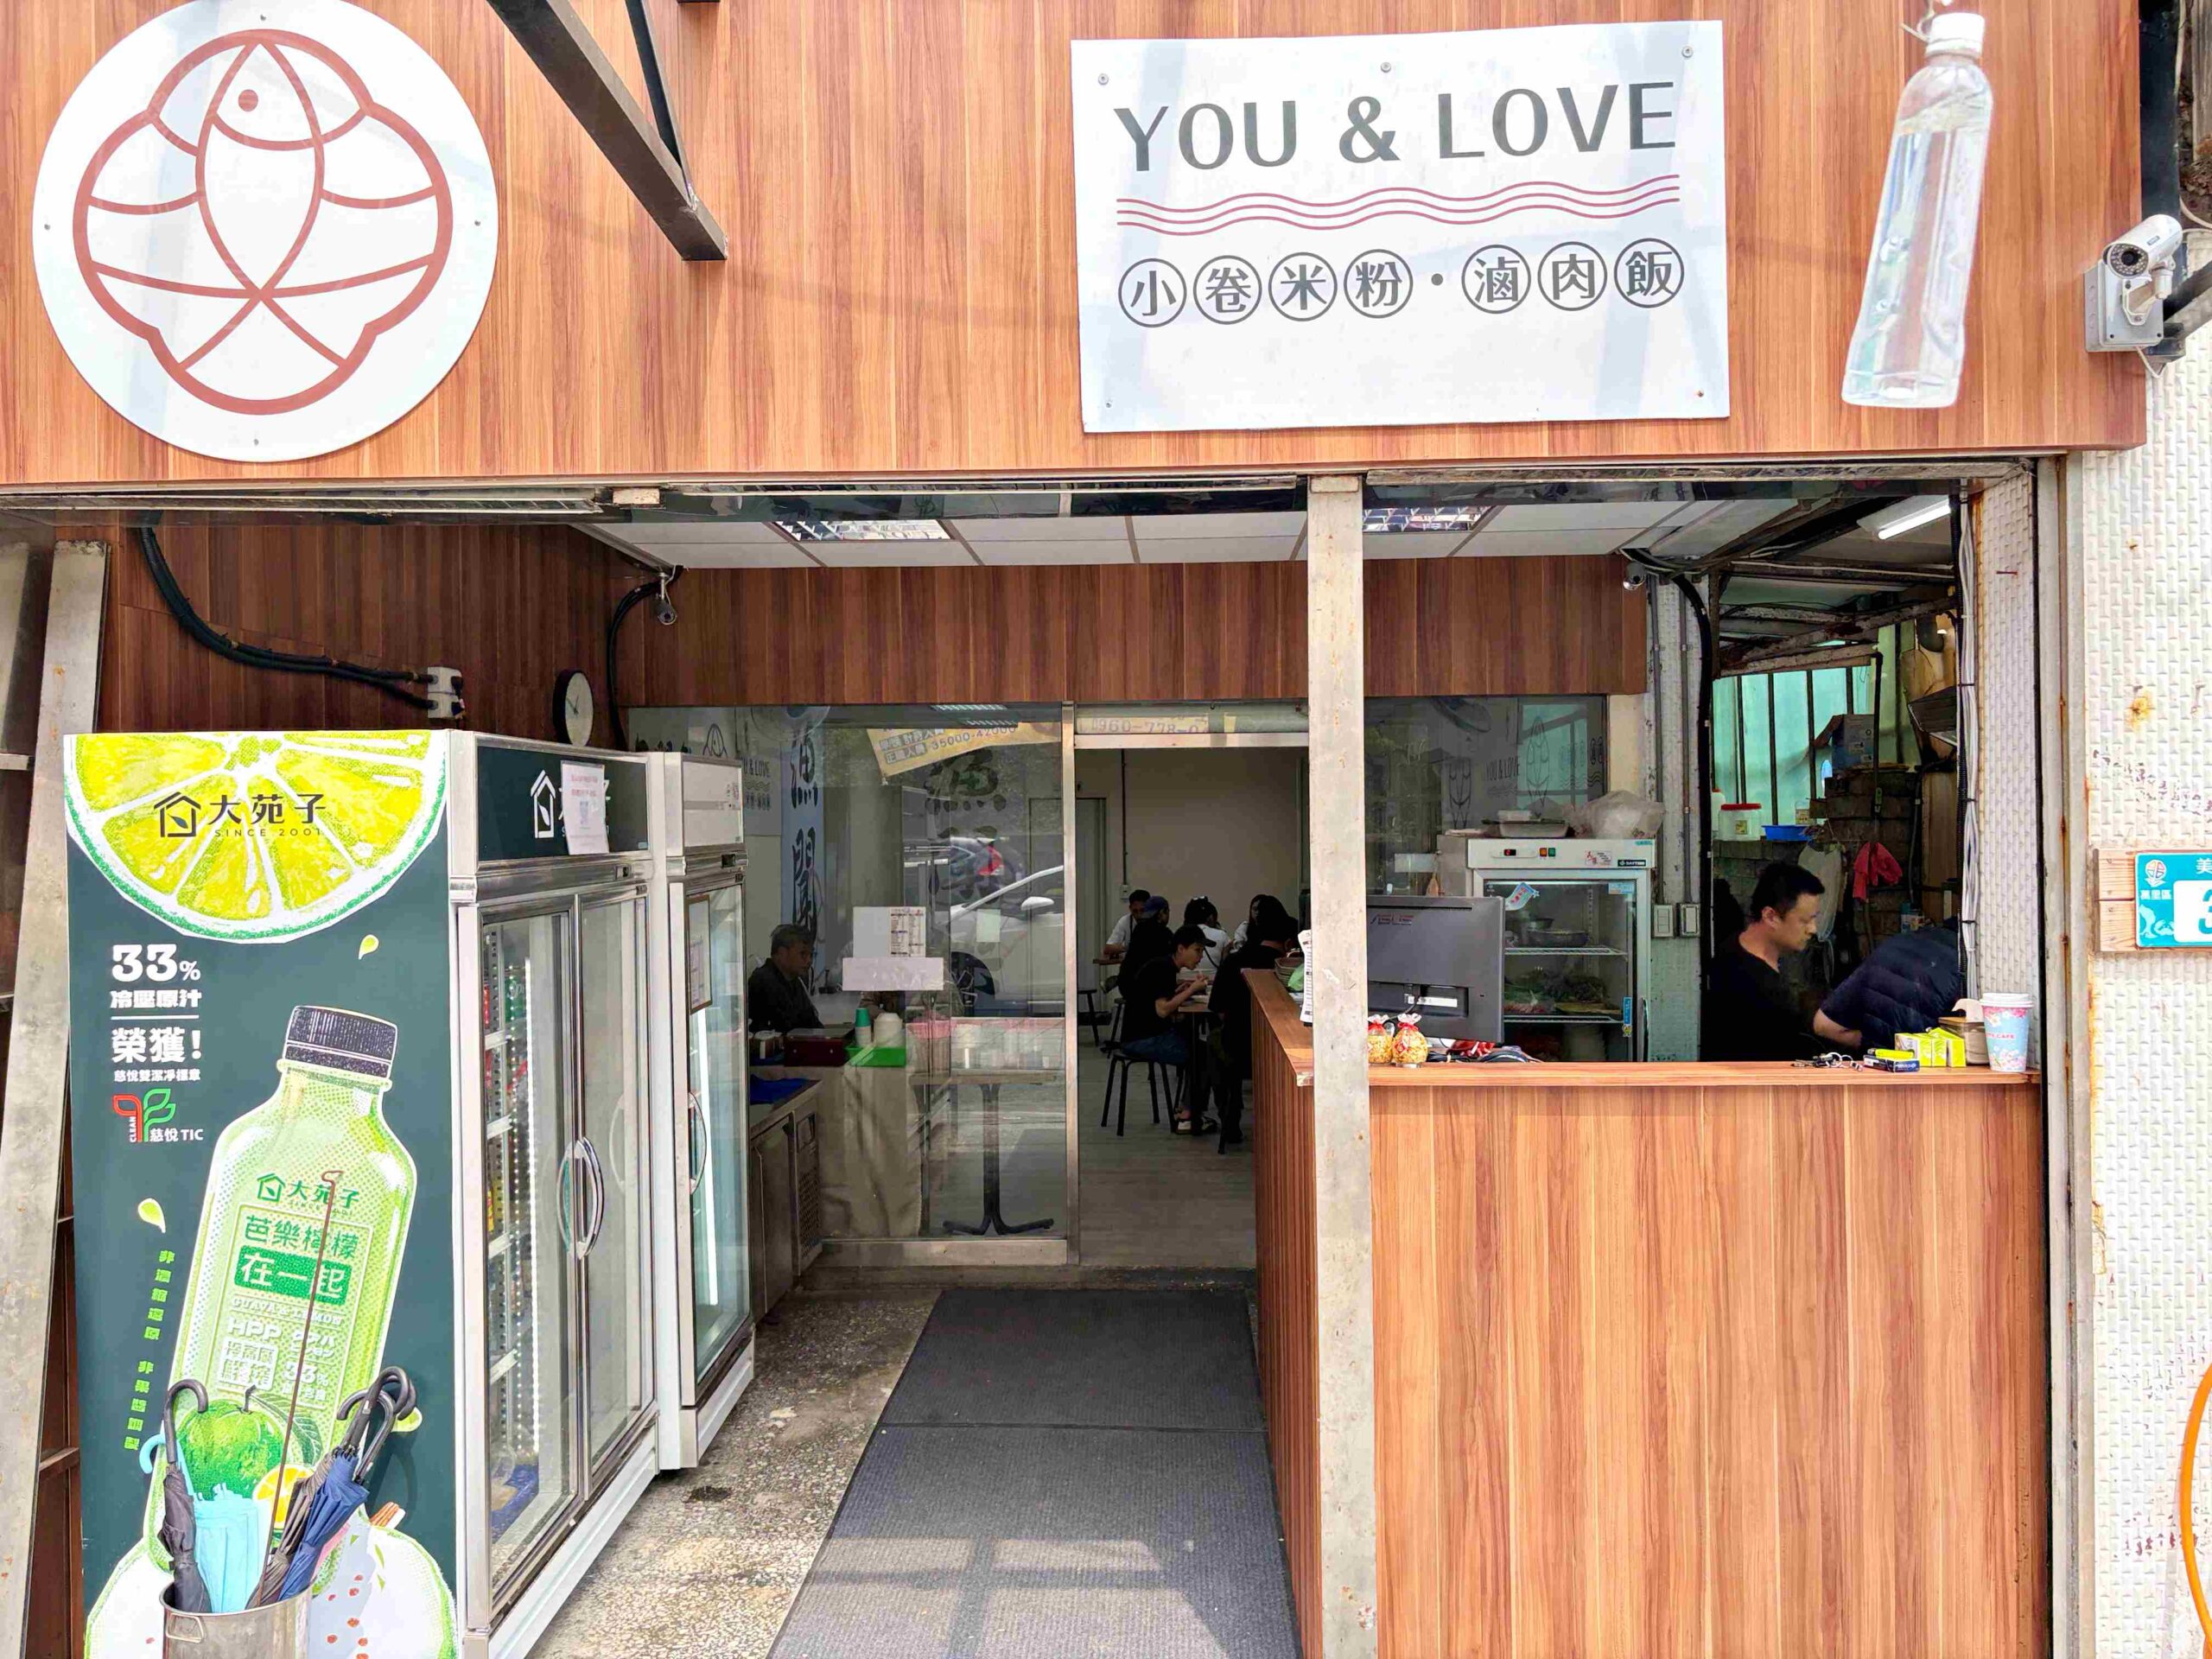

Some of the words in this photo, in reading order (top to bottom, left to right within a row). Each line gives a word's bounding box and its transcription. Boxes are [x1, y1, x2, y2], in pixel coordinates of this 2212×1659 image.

[1114, 100, 1297, 173] YOU
[1338, 95, 1401, 163] &
[1438, 80, 1677, 160] LOVE
[207, 793, 327, 825] 大苑子
[214, 828, 267, 837] SINCE
[278, 827, 321, 836] 2001
[111, 944, 201, 982] 33%
[111, 988, 202, 1009] 冷壓原汁
[129, 1116, 138, 1143] CLEAN
[149, 1128, 179, 1143] 慈悅
[181, 1128, 204, 1141] TIC
[288, 1179, 361, 1210] 大苑子
[245, 1215, 360, 1261] 芭樂檸檬
[241, 1254, 344, 1300] 在一起
[228, 1317, 283, 1341] HPP
